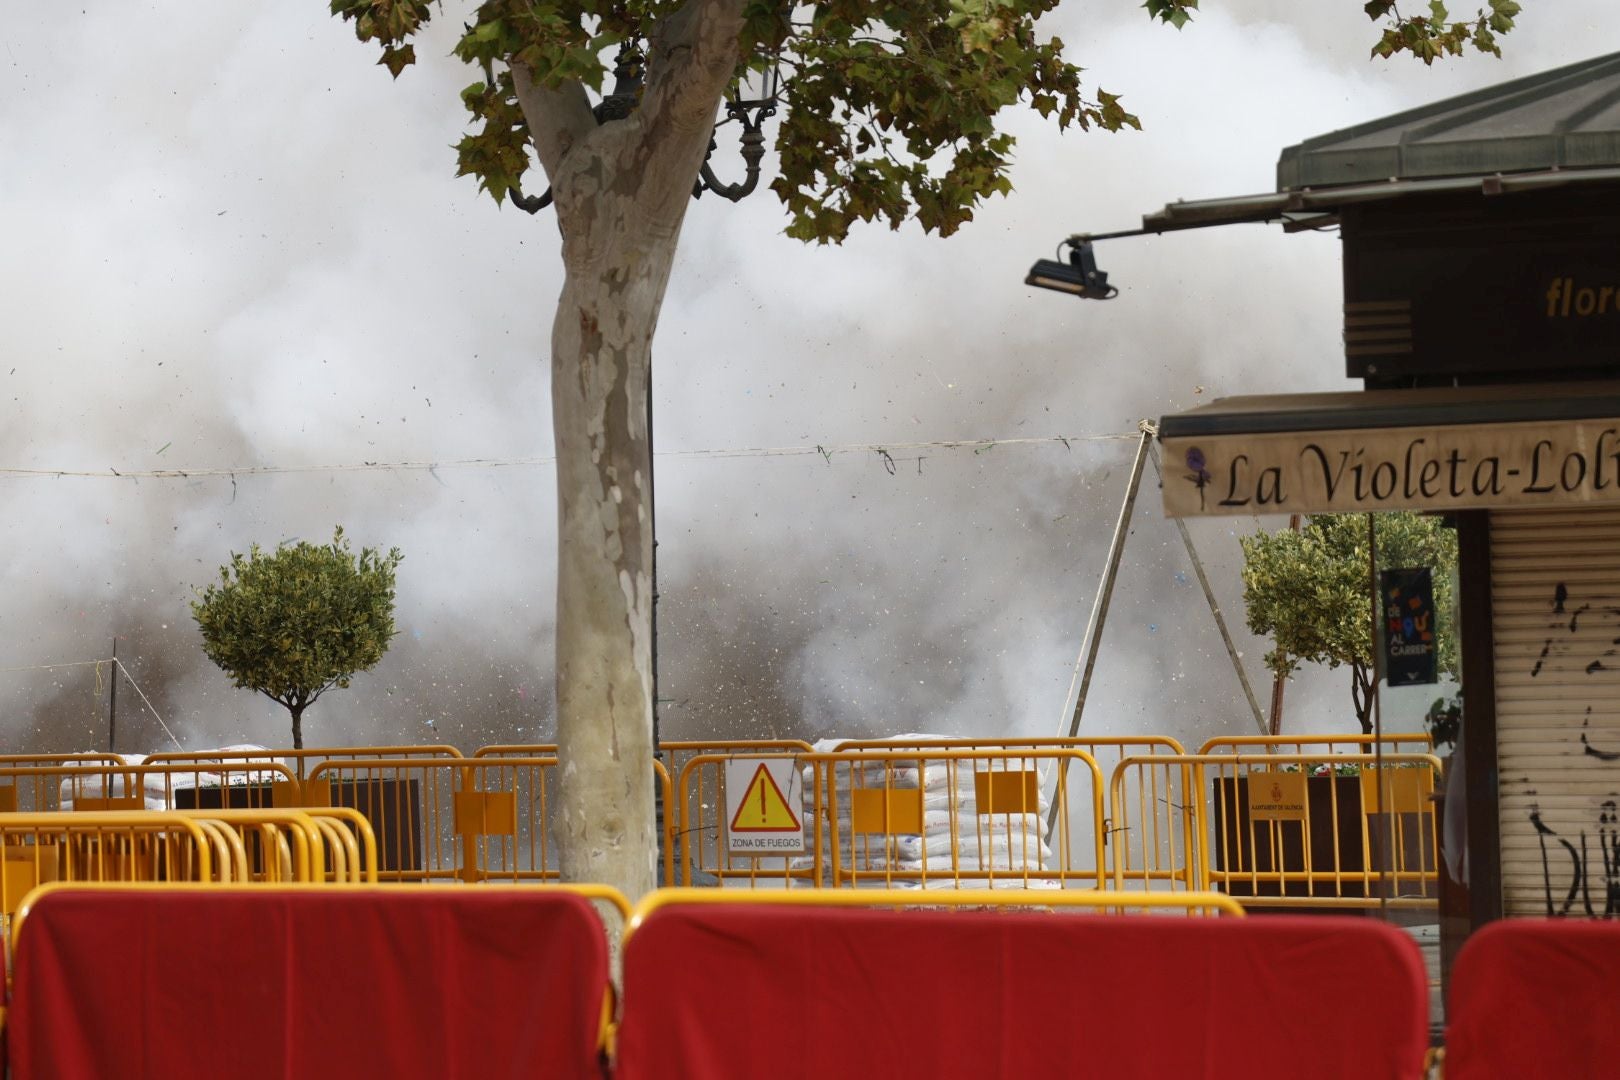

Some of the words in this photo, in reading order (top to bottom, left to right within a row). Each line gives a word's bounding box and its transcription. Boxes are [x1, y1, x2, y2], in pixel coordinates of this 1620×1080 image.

[1545, 273, 1620, 318] flor
[1217, 453, 1287, 507] La
[732, 838, 753, 847] ZONA
[755, 838, 766, 847] DE
[767, 838, 801, 848] FUEGOS
